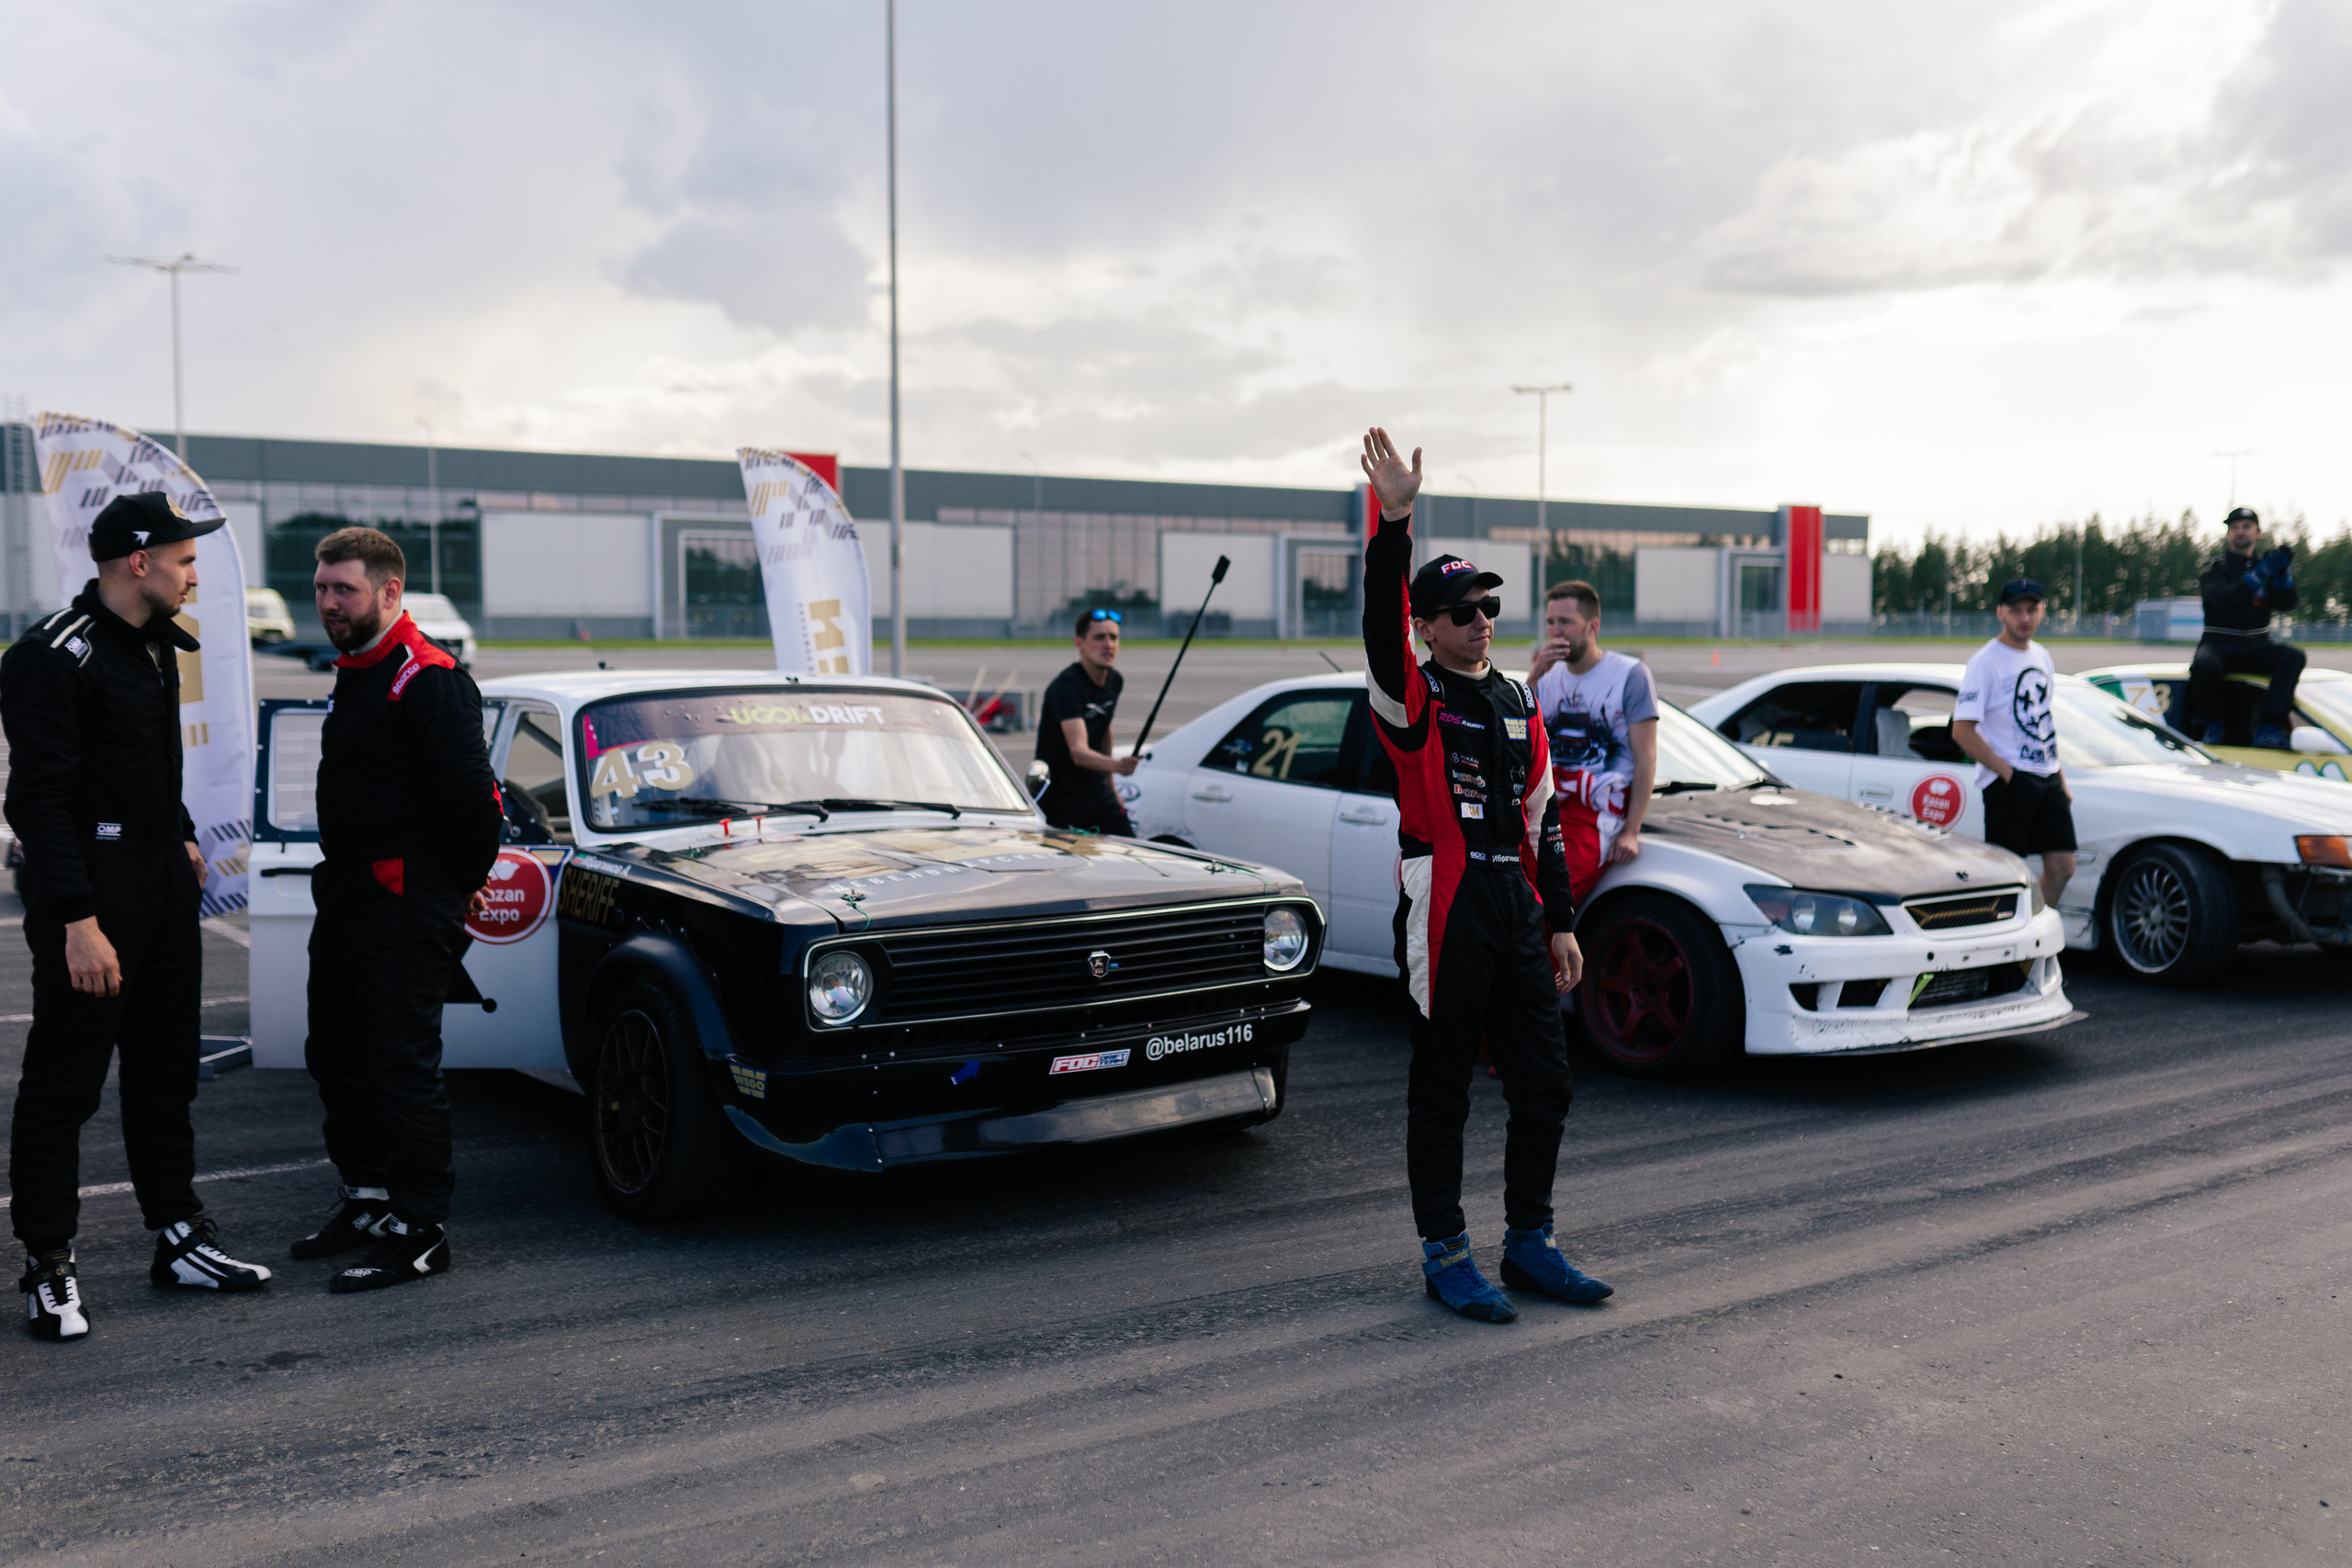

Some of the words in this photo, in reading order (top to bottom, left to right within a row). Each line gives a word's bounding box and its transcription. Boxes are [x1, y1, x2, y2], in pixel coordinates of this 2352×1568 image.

[392, 662, 420, 695] sparco
[2128, 683, 2171, 714] 73
[592, 740, 694, 799] 43
[1251, 728, 1301, 780] 21
[1923, 794, 1951, 810] Kazan
[96, 825, 121, 834] OMP
[484, 888, 525, 902] azan
[558, 866, 620, 924] SHERIFF
[1147, 1024, 1252, 1061] @belarus116
[733, 1074, 765, 1091] WEGO
